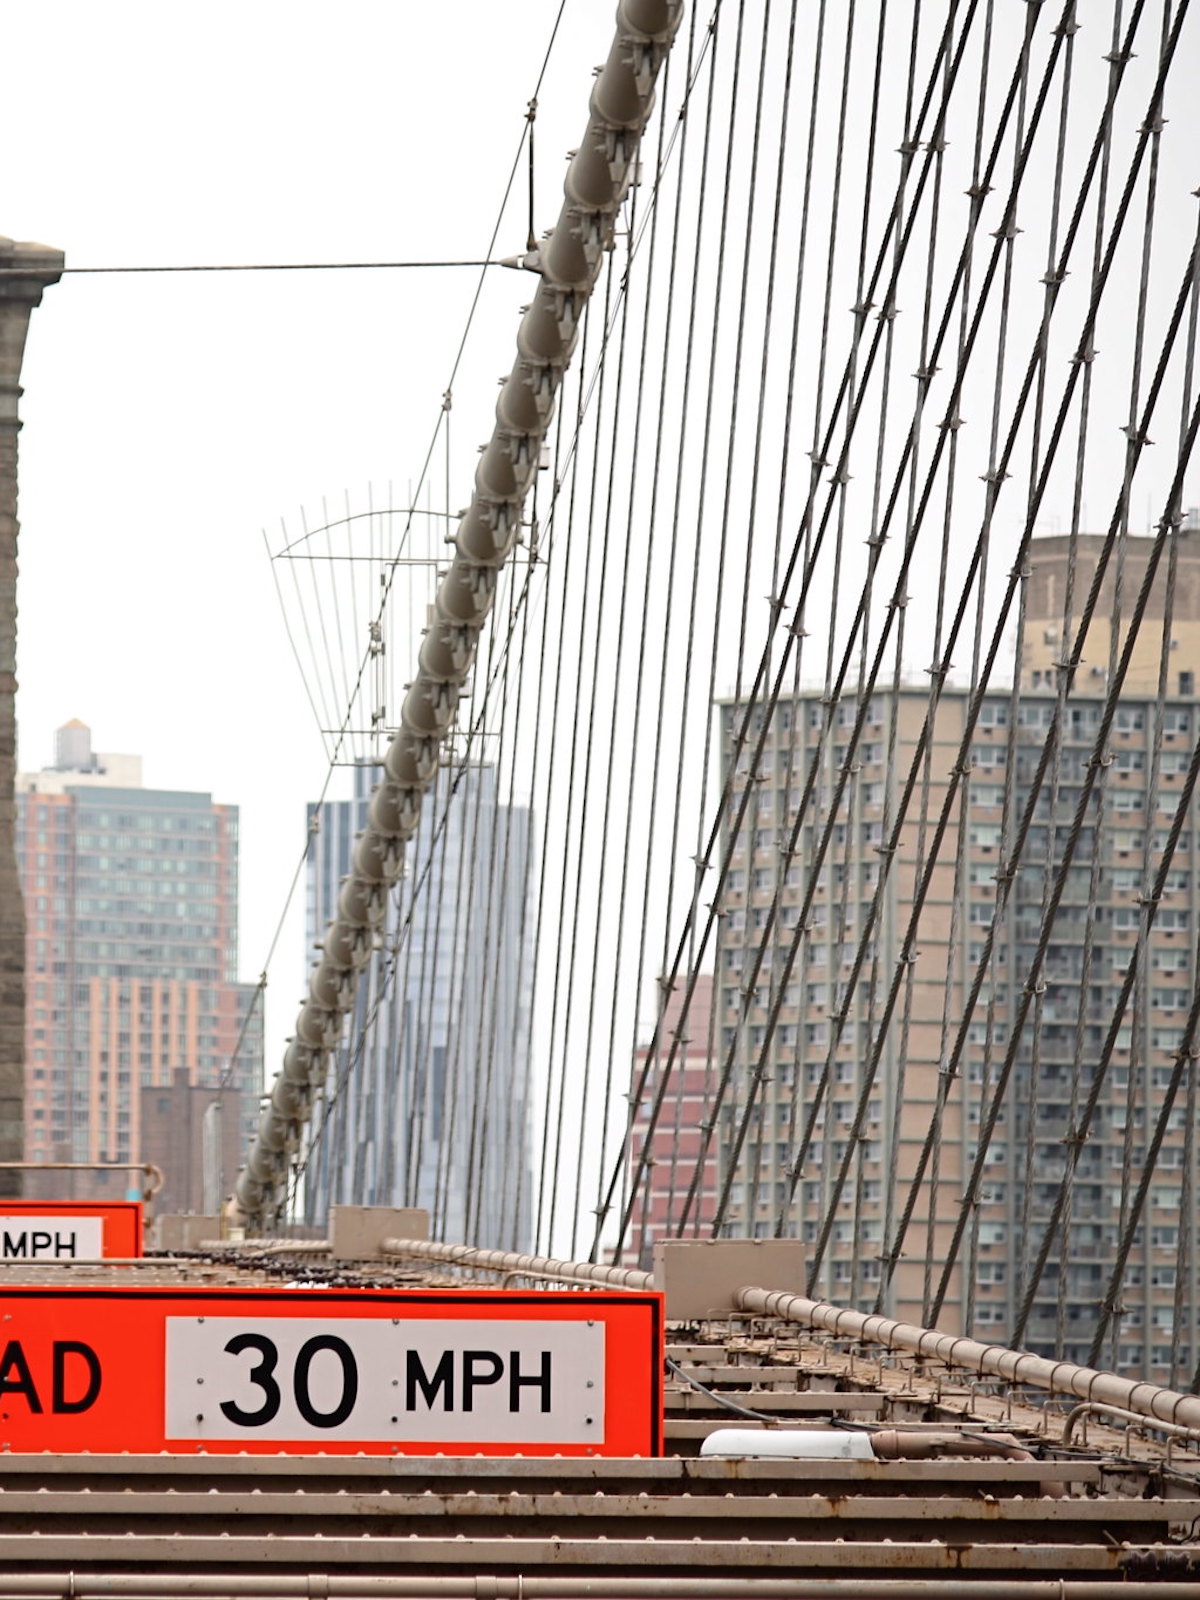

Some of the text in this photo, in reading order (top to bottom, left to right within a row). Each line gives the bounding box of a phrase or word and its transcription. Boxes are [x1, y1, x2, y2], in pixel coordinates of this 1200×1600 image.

[3, 1231, 77, 1258] MPH
[219, 1333, 553, 1429] 30 MPH
